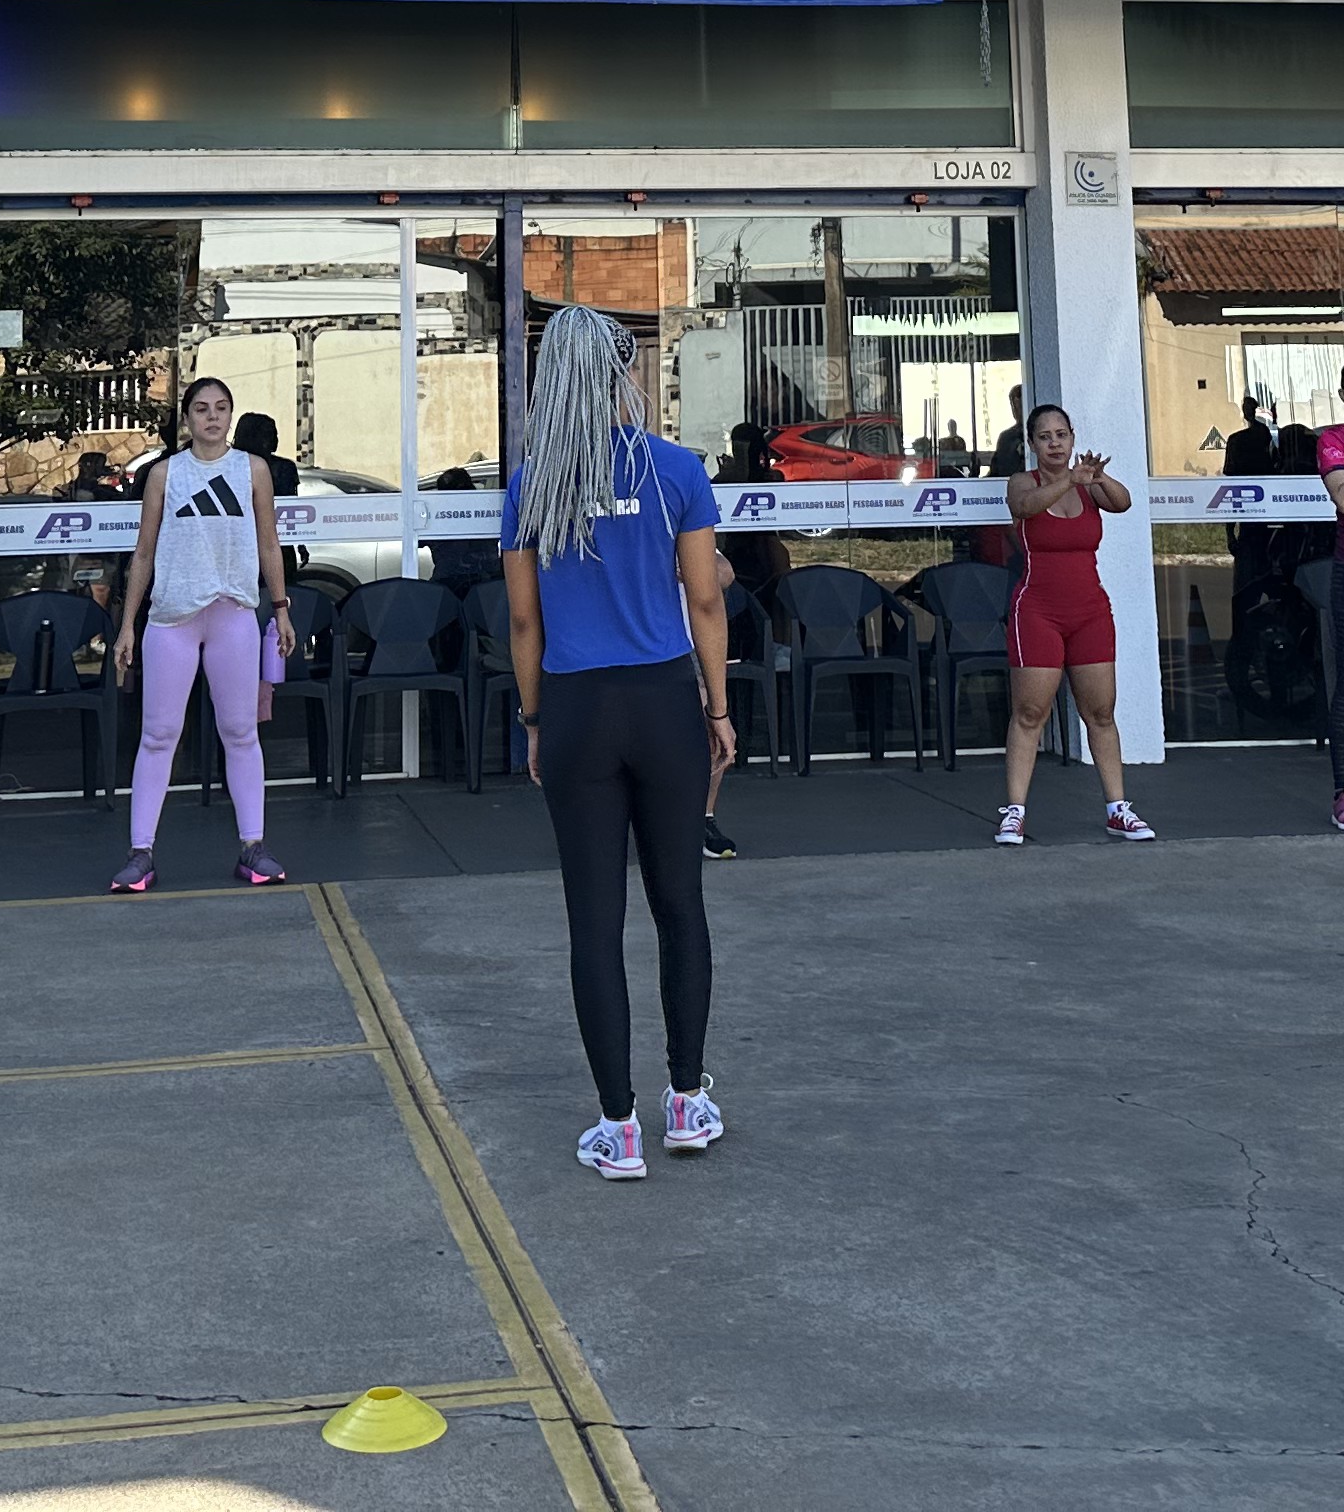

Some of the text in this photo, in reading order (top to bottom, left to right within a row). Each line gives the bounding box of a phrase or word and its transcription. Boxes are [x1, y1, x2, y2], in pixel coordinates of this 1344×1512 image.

[933, 161, 1012, 180] LOJA 02
[1167, 495, 1195, 504] REAIS
[1271, 494, 1328, 503] RESULTADOS
[322, 512, 399, 524] RESULTADOS REAIS
[0, 525, 25, 534] REAIS
[98, 521, 141, 531] RESULTAD
